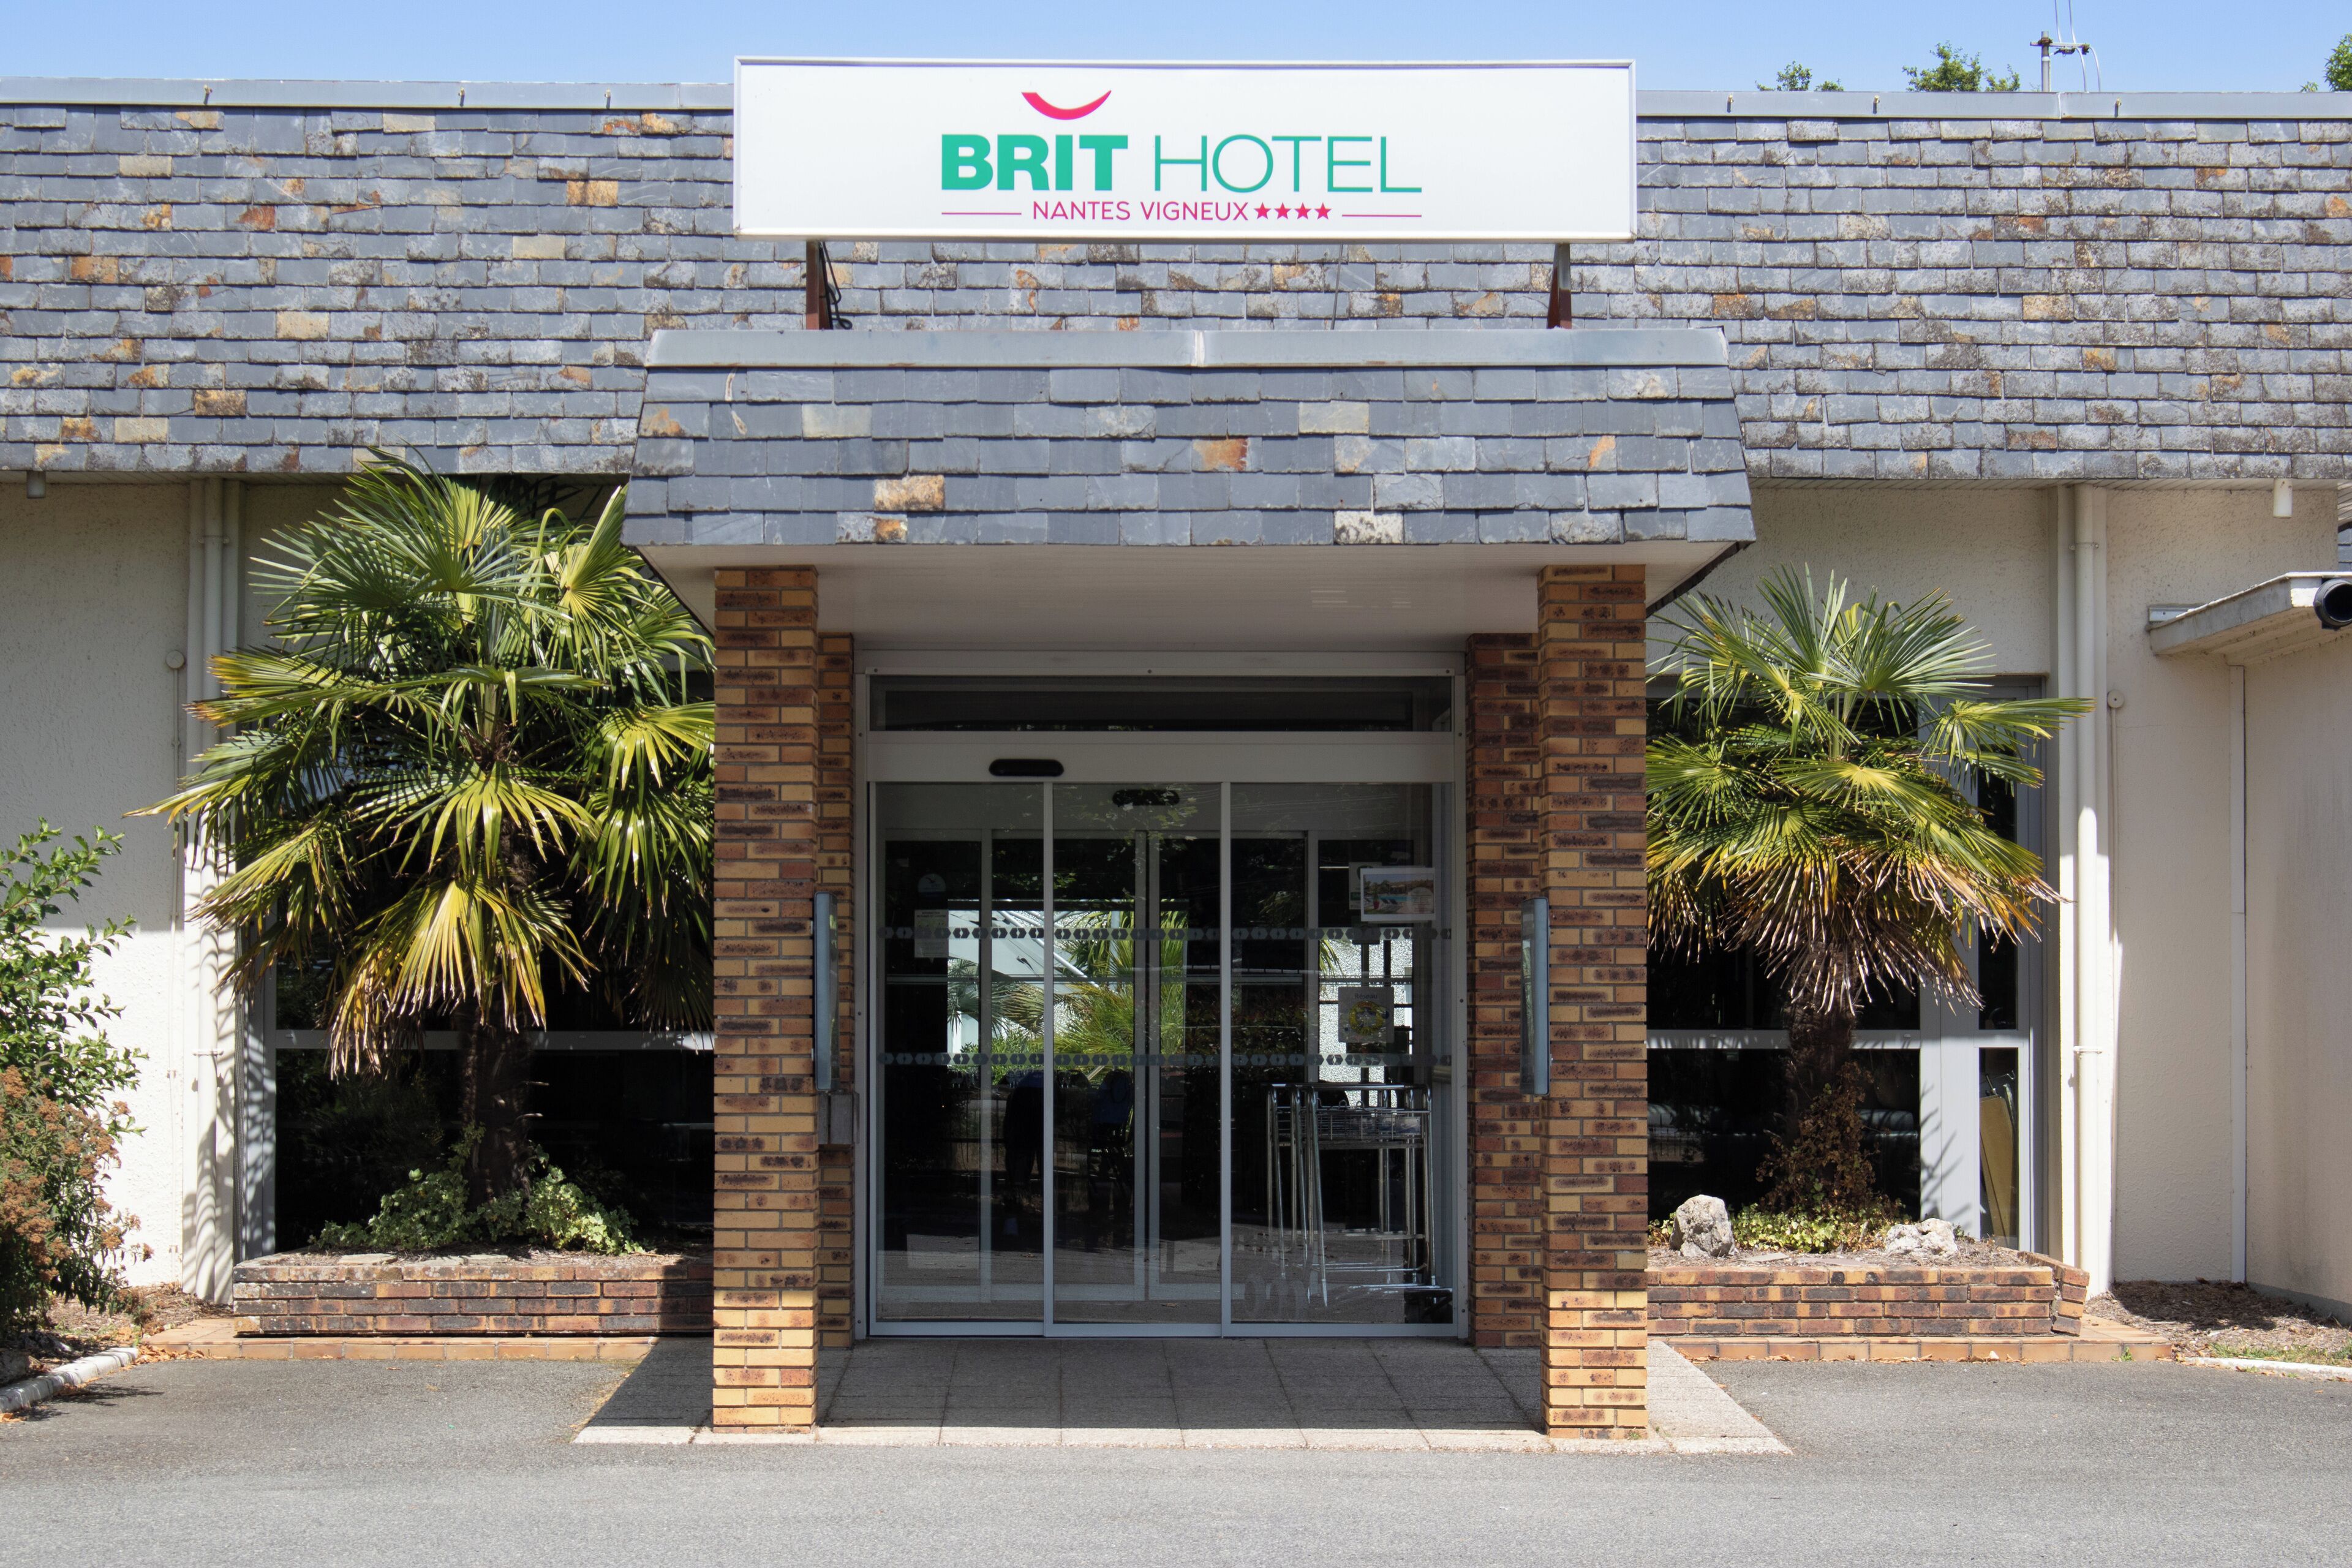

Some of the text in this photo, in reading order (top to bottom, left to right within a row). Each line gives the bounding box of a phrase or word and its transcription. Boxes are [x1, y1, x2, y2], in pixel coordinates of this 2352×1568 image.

[941, 134, 1422, 194] BRIT HOTEL
[1033, 200, 1248, 221] NANTES VIGNEUX
